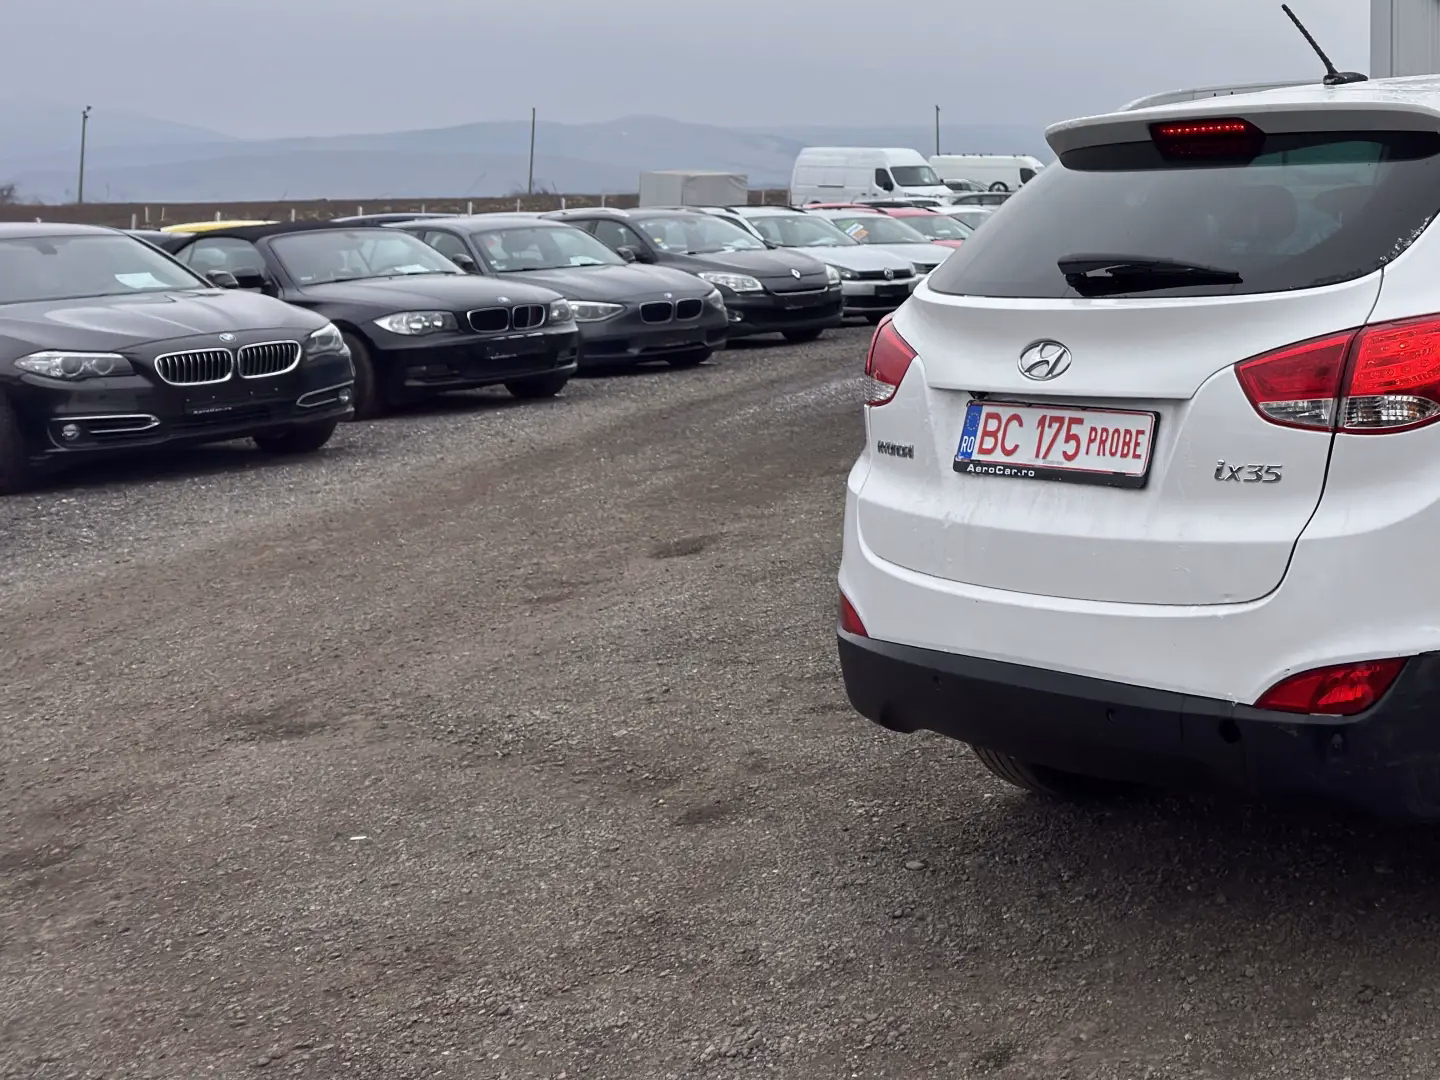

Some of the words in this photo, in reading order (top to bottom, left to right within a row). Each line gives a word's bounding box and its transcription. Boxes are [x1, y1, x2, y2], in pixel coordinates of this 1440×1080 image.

[960, 435, 975, 453] RO
[977, 412, 1023, 457] BC
[1035, 414, 1084, 462] 175
[1085, 426, 1145, 459] PROBE
[966, 463, 1035, 477] AeroCar.ro
[1214, 459, 1282, 483] ix35
